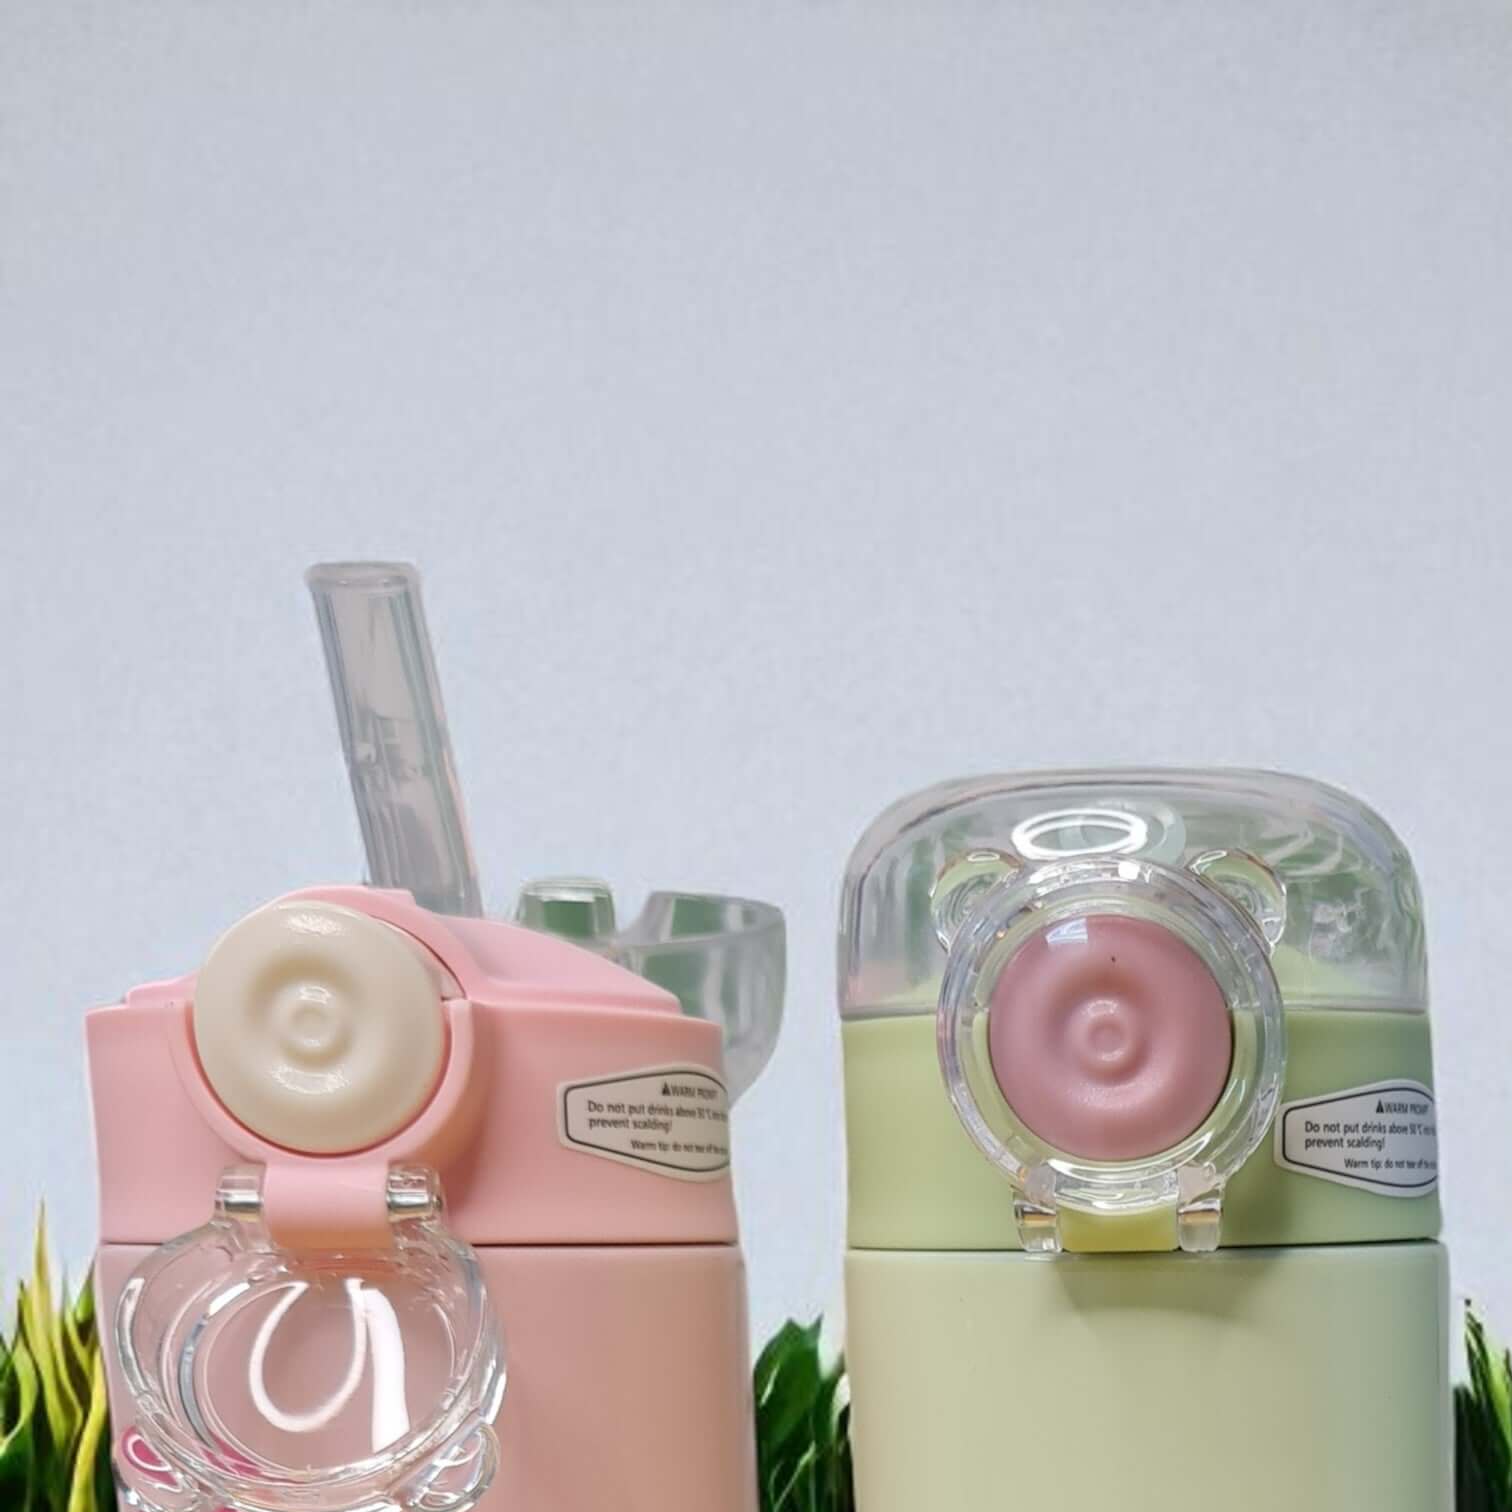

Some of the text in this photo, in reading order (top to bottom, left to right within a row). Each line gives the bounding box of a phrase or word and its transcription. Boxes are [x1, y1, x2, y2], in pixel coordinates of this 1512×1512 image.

[588, 1100, 604, 1113] Do
[608, 1101, 626, 1114] not
[628, 1103, 645, 1117] put
[648, 1103, 673, 1117] drinks
[589, 1116, 630, 1130] prevent
[1305, 1121, 1320, 1134] Do
[1323, 1121, 1340, 1134] not
[1343, 1122, 1360, 1136] put
[1361, 1121, 1387, 1135] drinks
[631, 1139, 656, 1151] Warm
[1305, 1137, 1386, 1152] prevent scalding!
[1344, 1158, 1369, 1169] Warm
[1384, 1158, 1394, 1169] do
